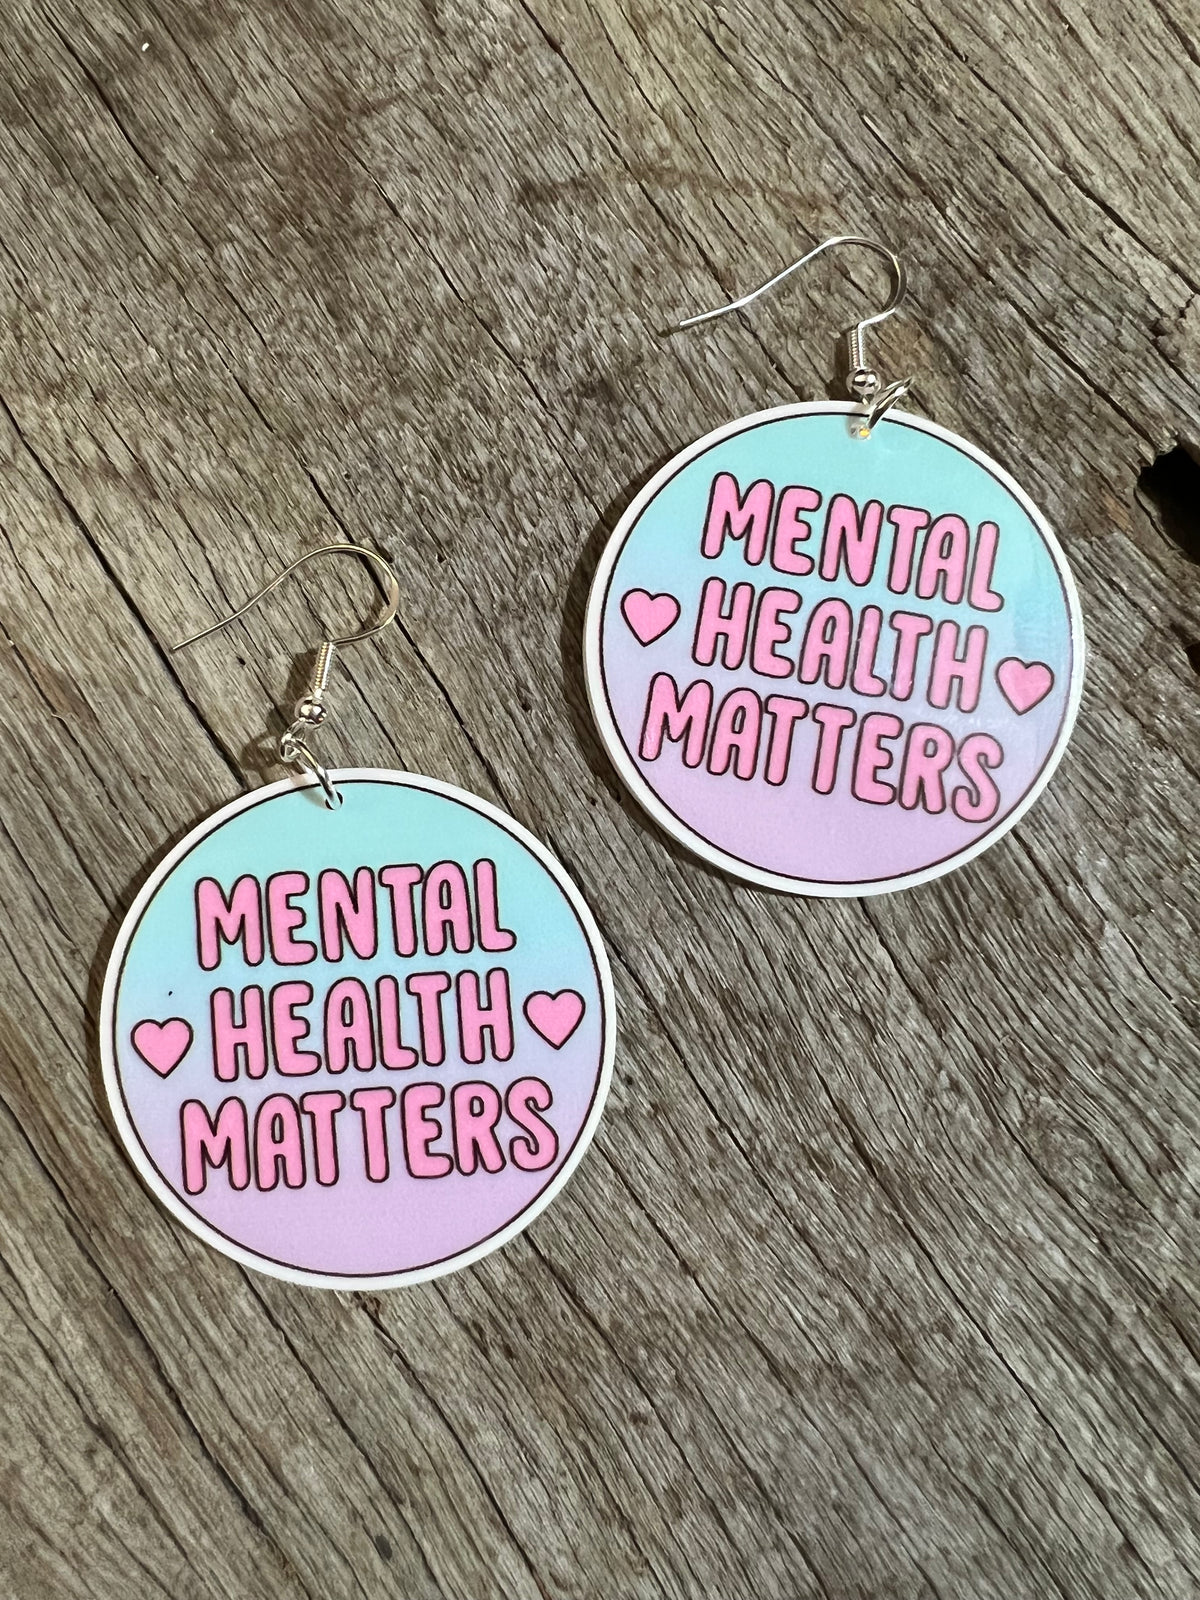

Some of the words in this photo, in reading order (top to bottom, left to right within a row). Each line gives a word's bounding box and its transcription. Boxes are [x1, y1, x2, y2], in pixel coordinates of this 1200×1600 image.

[700, 471, 1004, 612] MENTAL
[692, 576, 989, 713] HEALTH
[638, 671, 1004, 823] MATTERS
[194, 858, 517, 971] MENTAL
[210, 967, 514, 1082] HEALTH
[180, 1076, 559, 1195] MATTERS
